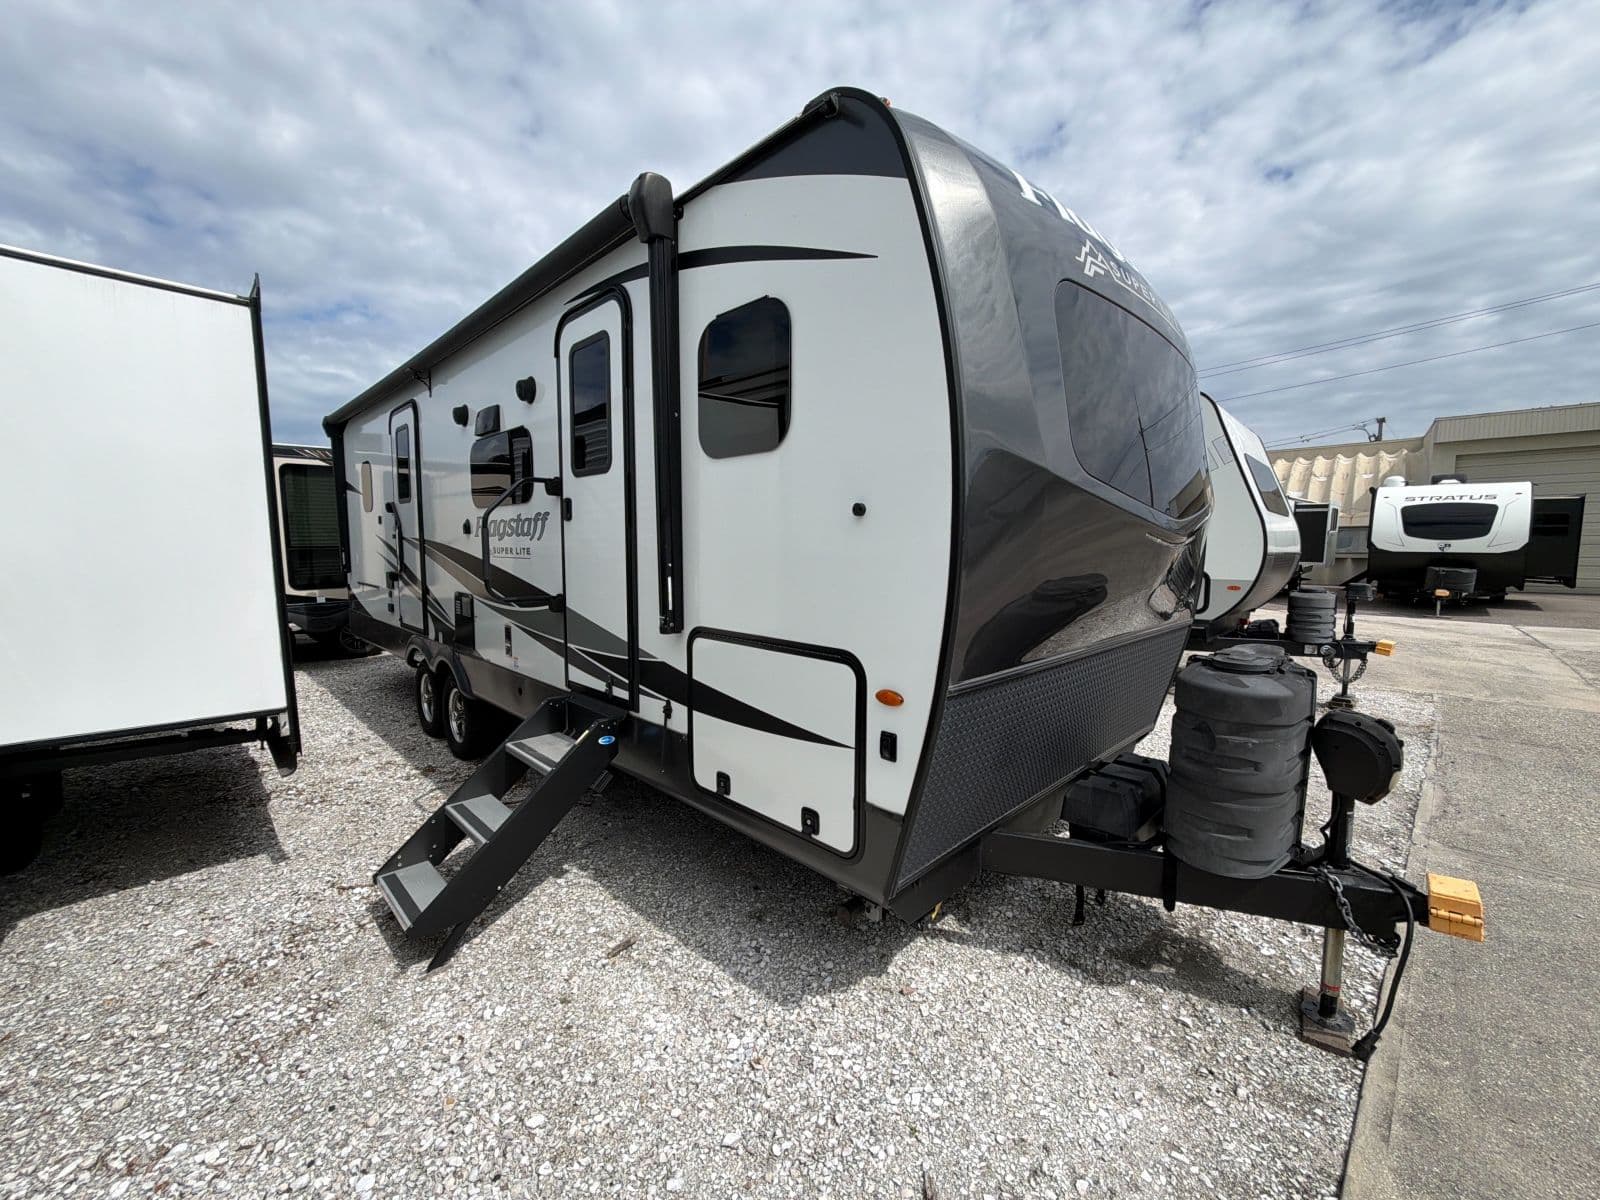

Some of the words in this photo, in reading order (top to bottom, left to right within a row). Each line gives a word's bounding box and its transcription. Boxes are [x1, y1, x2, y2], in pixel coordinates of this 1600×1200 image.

[1404, 493, 1498, 502] STRATUS
[474, 511, 550, 541] Fagstaff
[492, 546, 514, 555] SUPER
[515, 547, 531, 555] LITE
